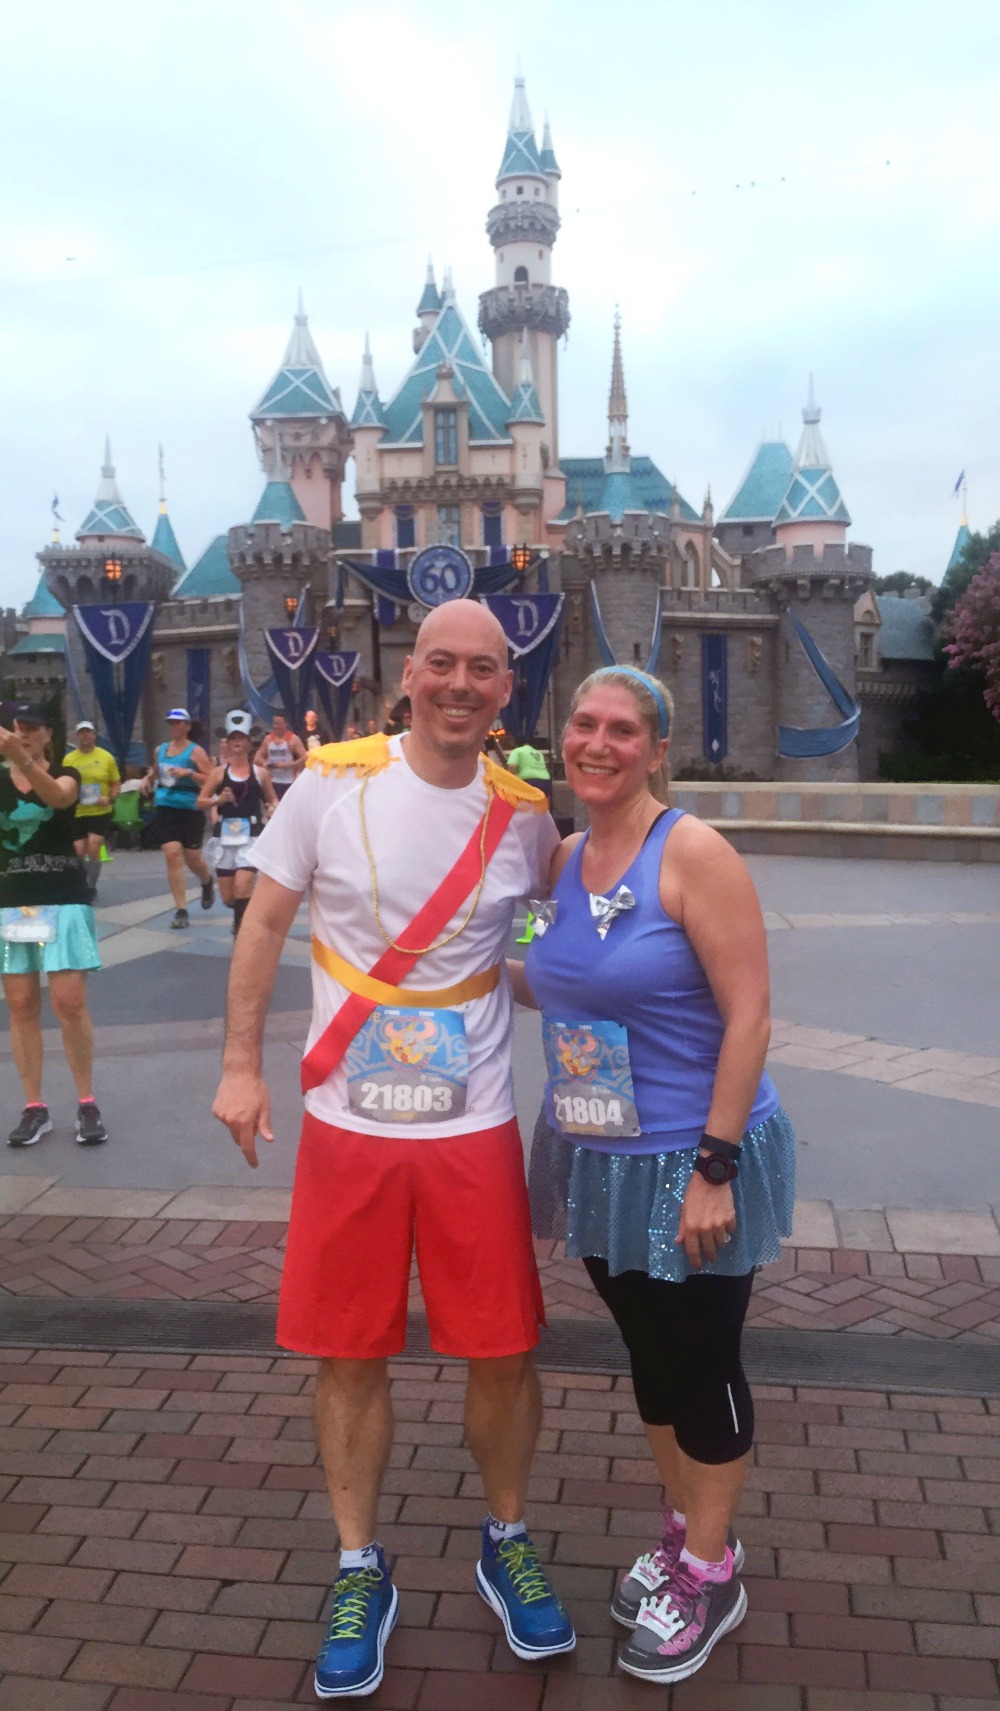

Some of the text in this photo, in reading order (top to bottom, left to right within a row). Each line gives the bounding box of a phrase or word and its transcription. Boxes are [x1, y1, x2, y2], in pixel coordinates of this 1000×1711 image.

[420, 563, 462, 593] 60
[100, 609, 130, 645] D
[511, 599, 539, 637] D
[283, 631, 304, 657] D
[328, 655, 346, 676] D
[360, 1082, 453, 1112] 21803
[553, 1093, 624, 1126] 21804
